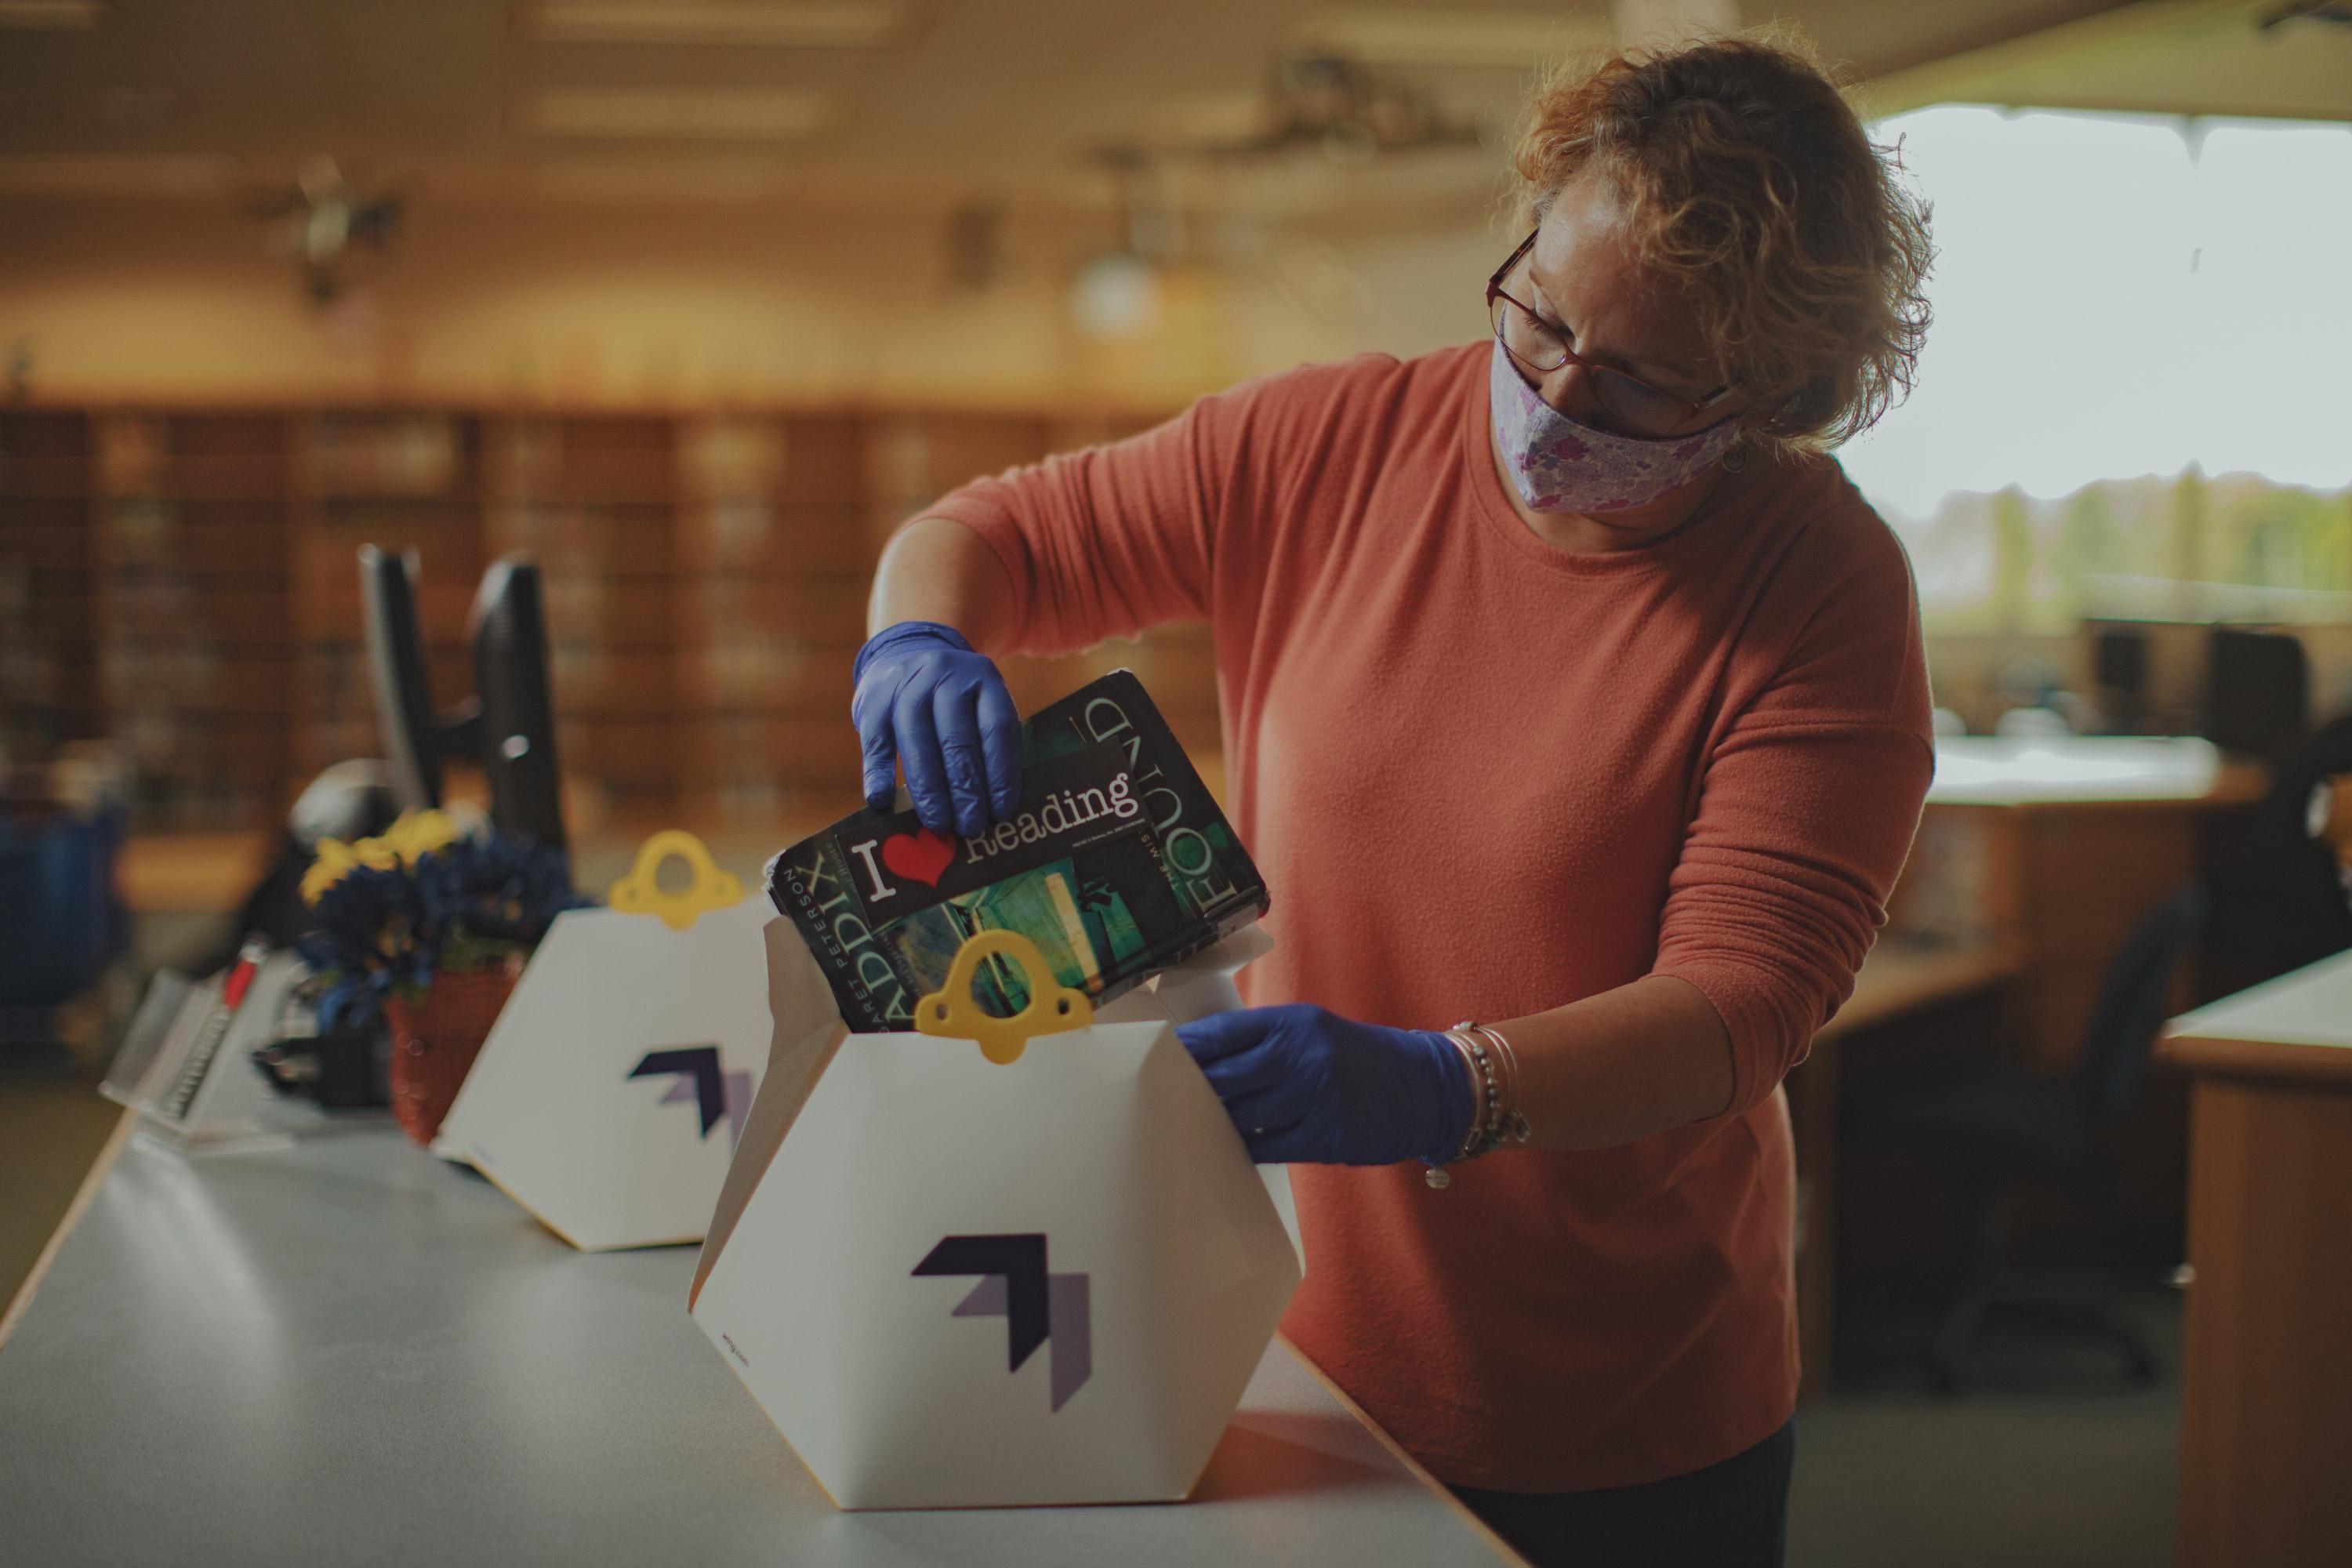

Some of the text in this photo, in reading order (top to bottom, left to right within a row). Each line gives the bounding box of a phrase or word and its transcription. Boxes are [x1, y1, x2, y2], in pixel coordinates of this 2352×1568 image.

[851, 772, 1138, 902] I Reading
[1085, 698, 1237, 912] FOUND
[1141, 833, 1178, 890] THE MIS
[784, 869, 848, 969] PETERSON
[795, 850, 916, 1022] ADDIX
